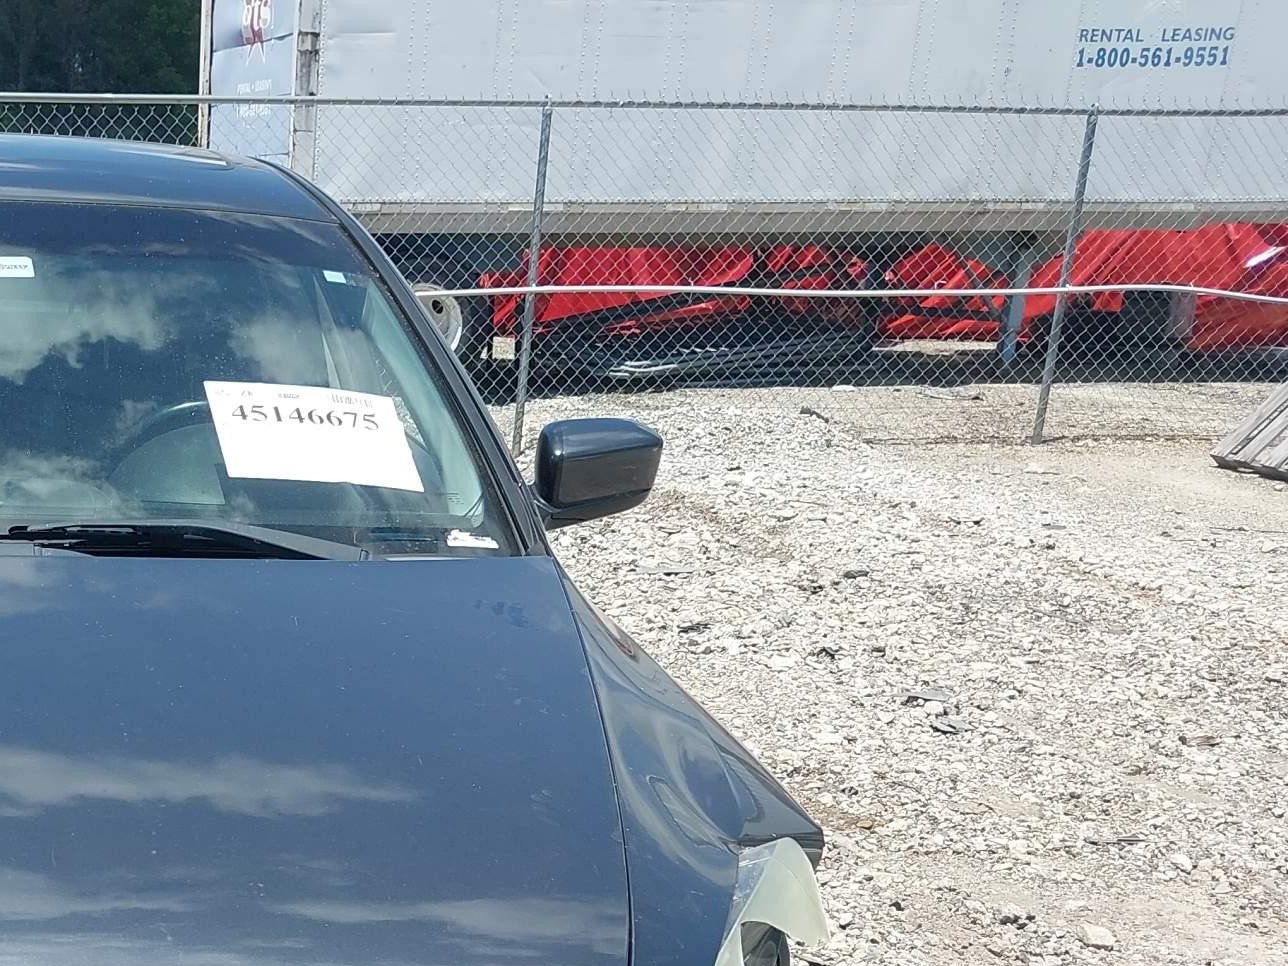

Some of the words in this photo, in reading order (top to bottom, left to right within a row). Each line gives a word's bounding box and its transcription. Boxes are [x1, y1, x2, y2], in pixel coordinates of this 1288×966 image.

[1078, 28, 1145, 43] RENTAL
[1161, 26, 1236, 42] LEASING
[1076, 45, 1230, 68] 1-800-561-9551
[231, 404, 380, 431] 45146675
